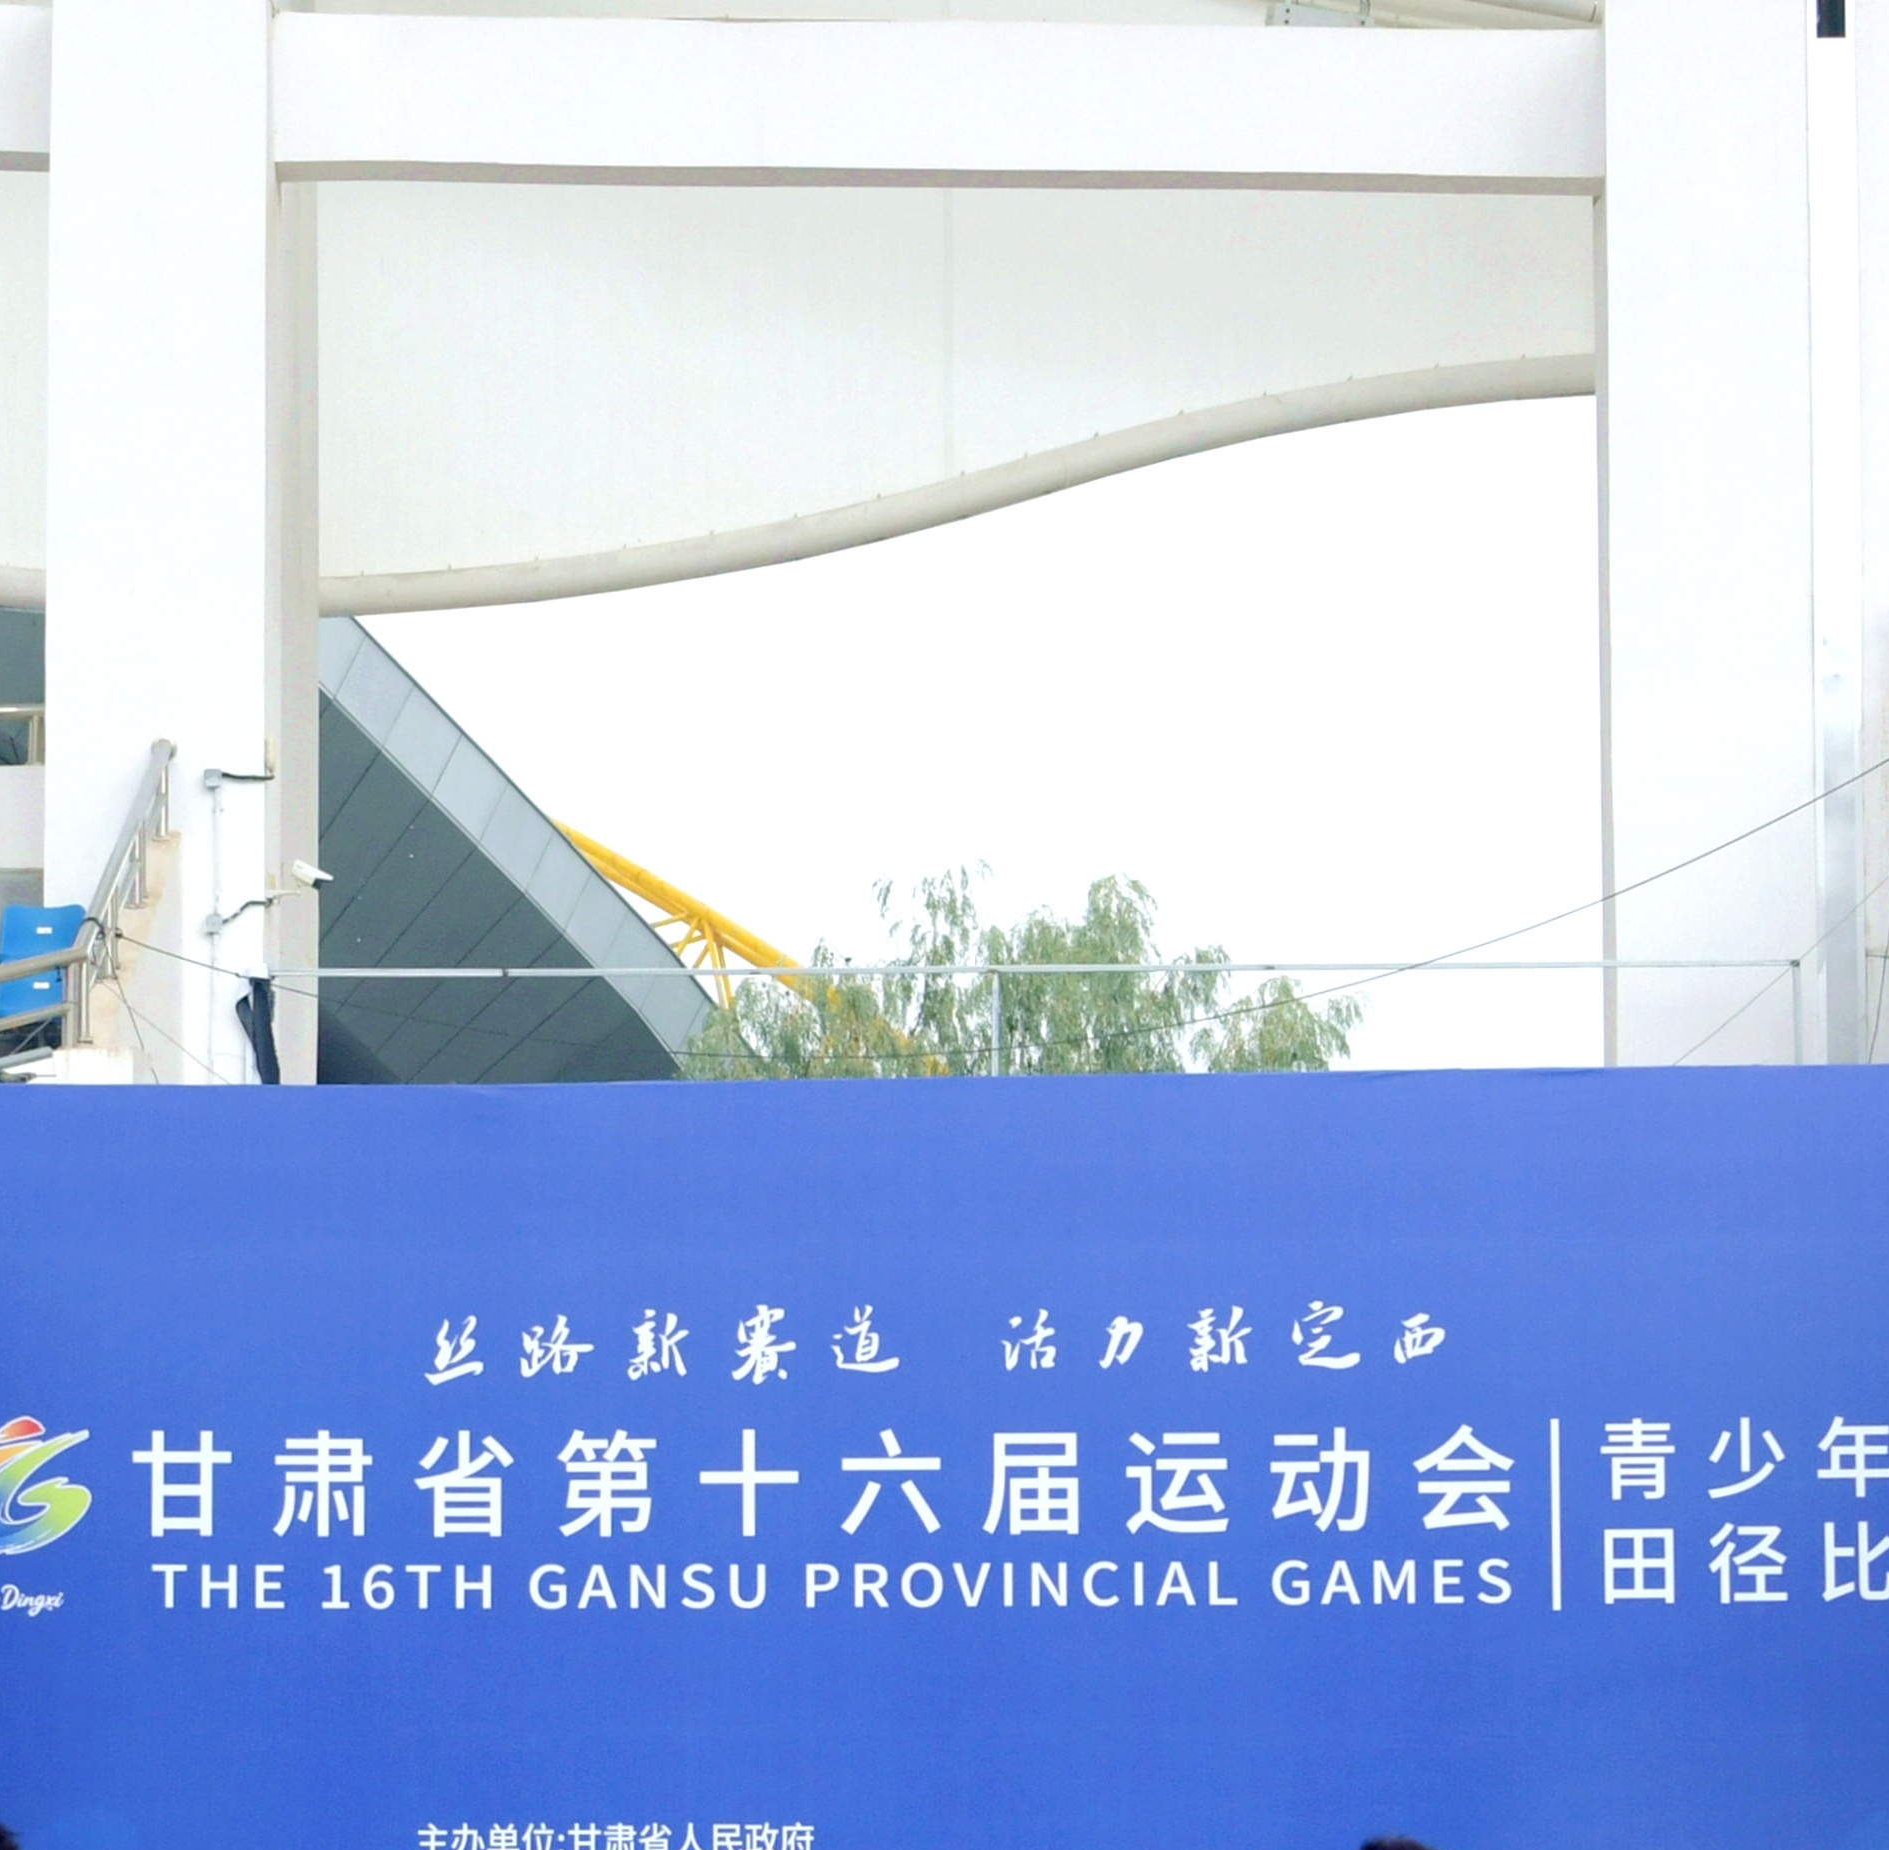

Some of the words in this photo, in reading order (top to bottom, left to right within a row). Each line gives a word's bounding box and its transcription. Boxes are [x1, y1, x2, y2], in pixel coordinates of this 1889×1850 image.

[132, 1424, 1515, 1538] 甘肃省第十六届运动会
[151, 1564, 285, 1609] THE
[322, 1564, 492, 1610] 16TH
[529, 1563, 766, 1610] GANSU
[805, 1560, 1238, 1608] PROVINCIAL
[1271, 1558, 1512, 1606] GAMES
